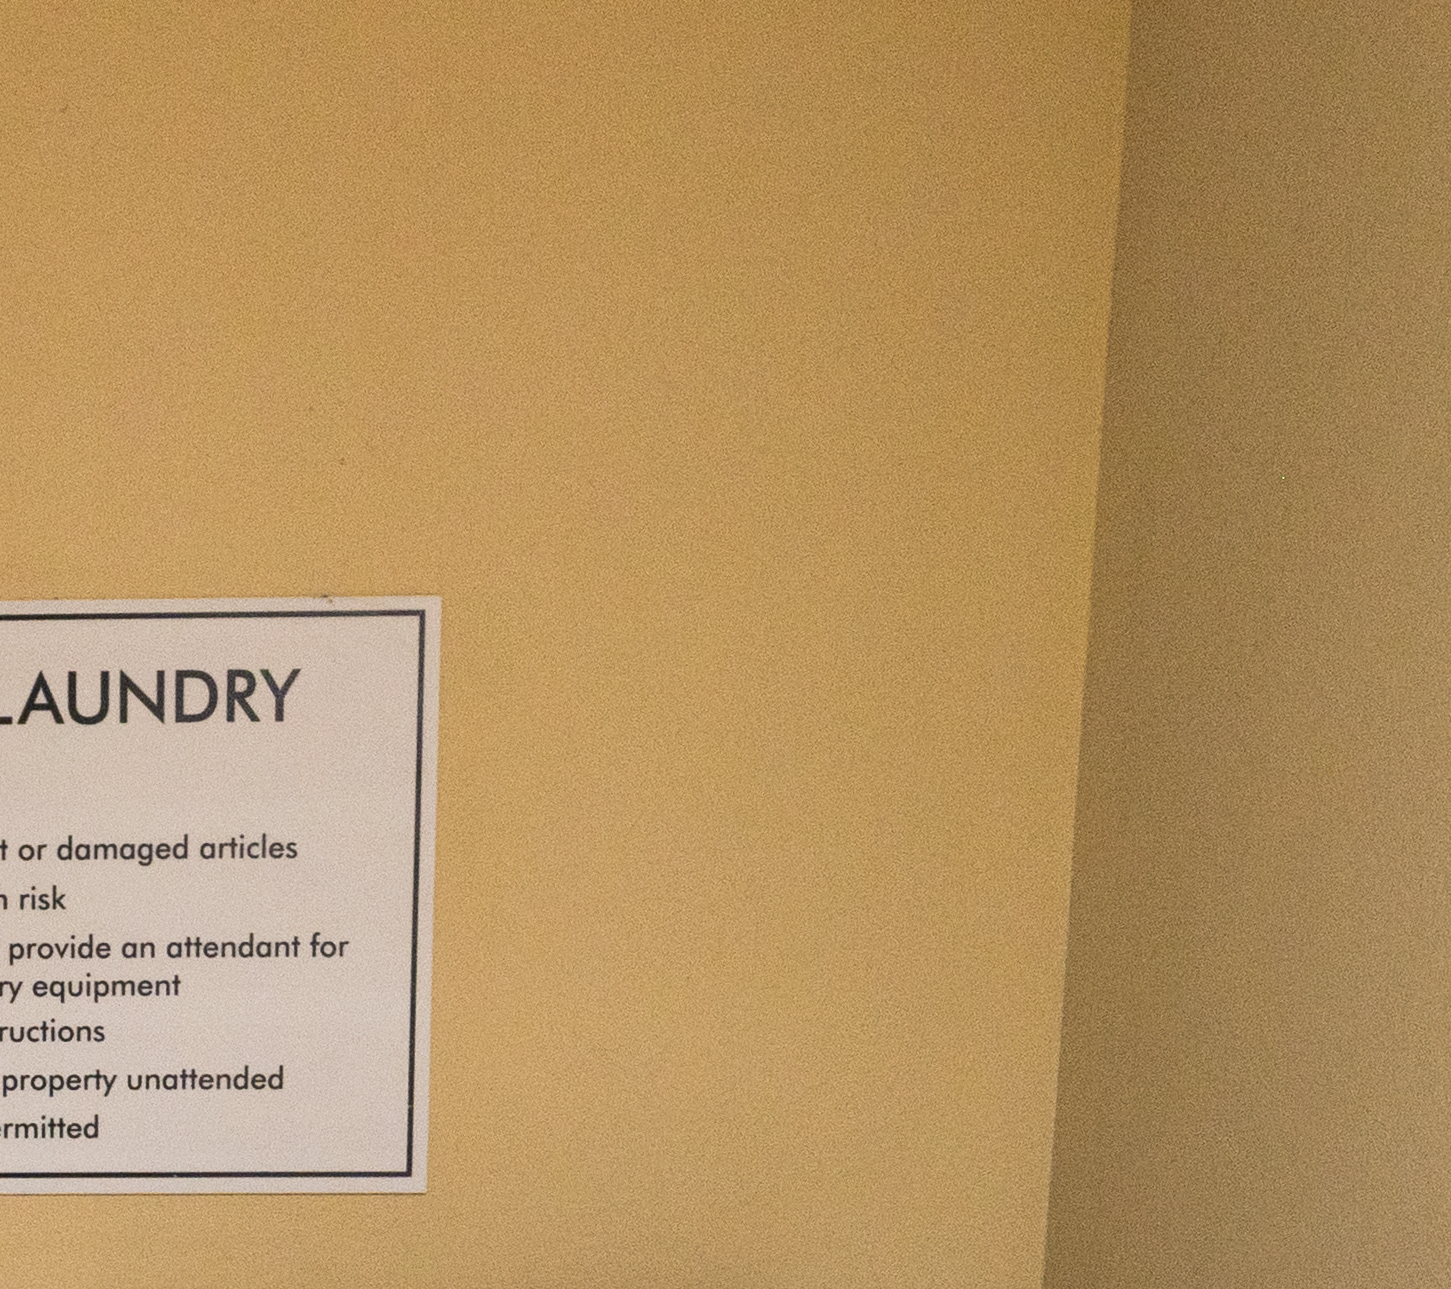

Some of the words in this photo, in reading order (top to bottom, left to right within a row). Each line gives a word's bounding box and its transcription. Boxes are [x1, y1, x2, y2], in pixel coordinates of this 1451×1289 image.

[19, 845, 47, 861] or
[57, 834, 188, 866] damaged
[200, 834, 297, 859] articles
[20, 885, 65, 910] risk
[10, 934, 110, 965] provide
[122, 942, 155, 958] an
[167, 933, 300, 958] attendant
[310, 932, 349, 957] for
[33, 975, 180, 1003] equipment
[3, 1070, 116, 1097] property
[128, 1065, 283, 1090] unattended
